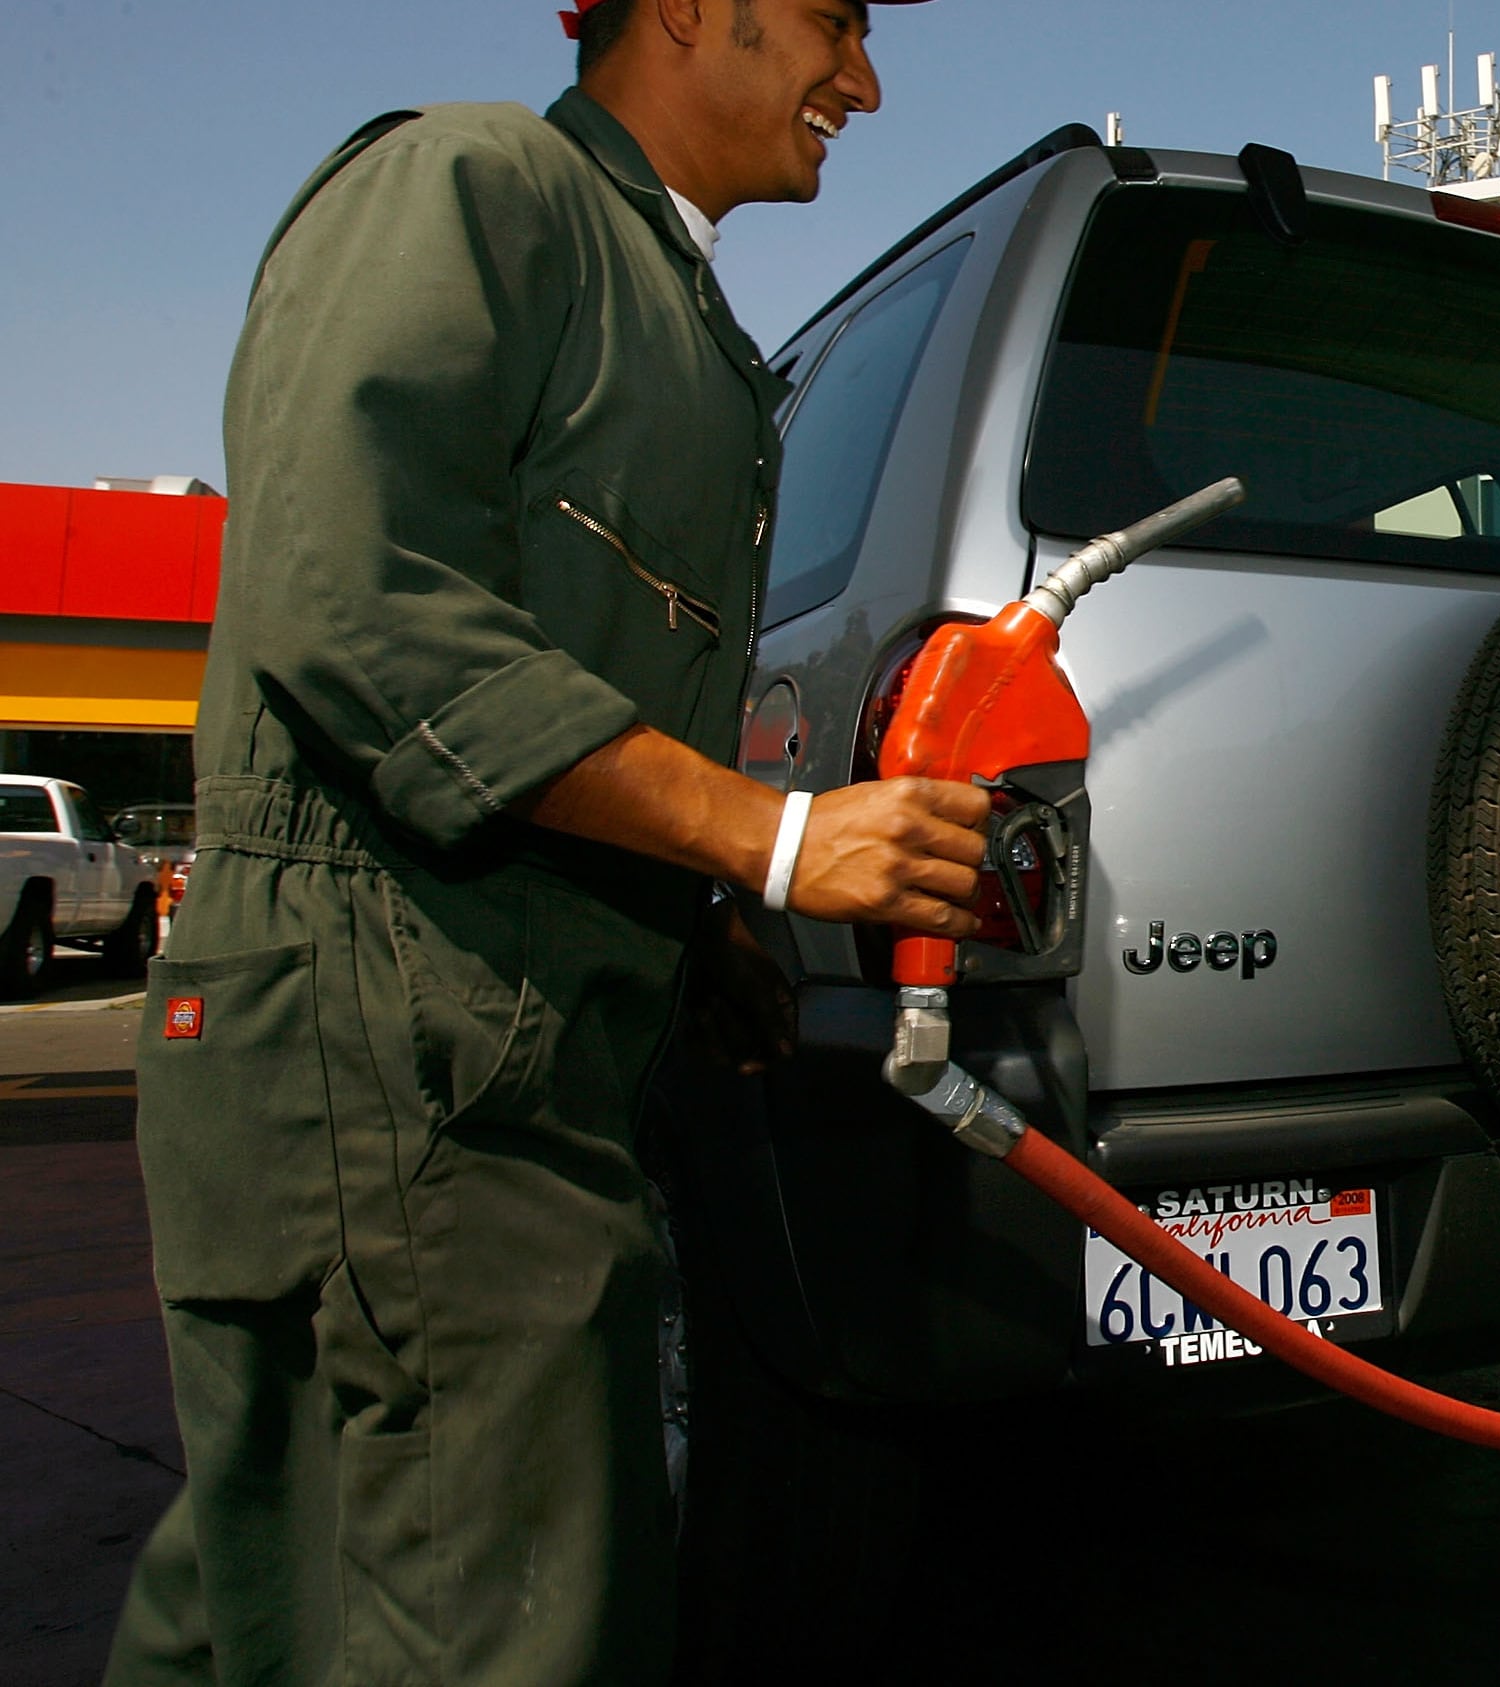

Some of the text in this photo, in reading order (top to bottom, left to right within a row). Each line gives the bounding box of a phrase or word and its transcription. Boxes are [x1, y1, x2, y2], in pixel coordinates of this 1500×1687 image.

[1122, 920, 1278, 980] Jeep
[1156, 1178, 1314, 1218] SATURN
[1338, 1191, 1365, 1206] 2008
[1160, 1206, 1331, 1249] alifornia
